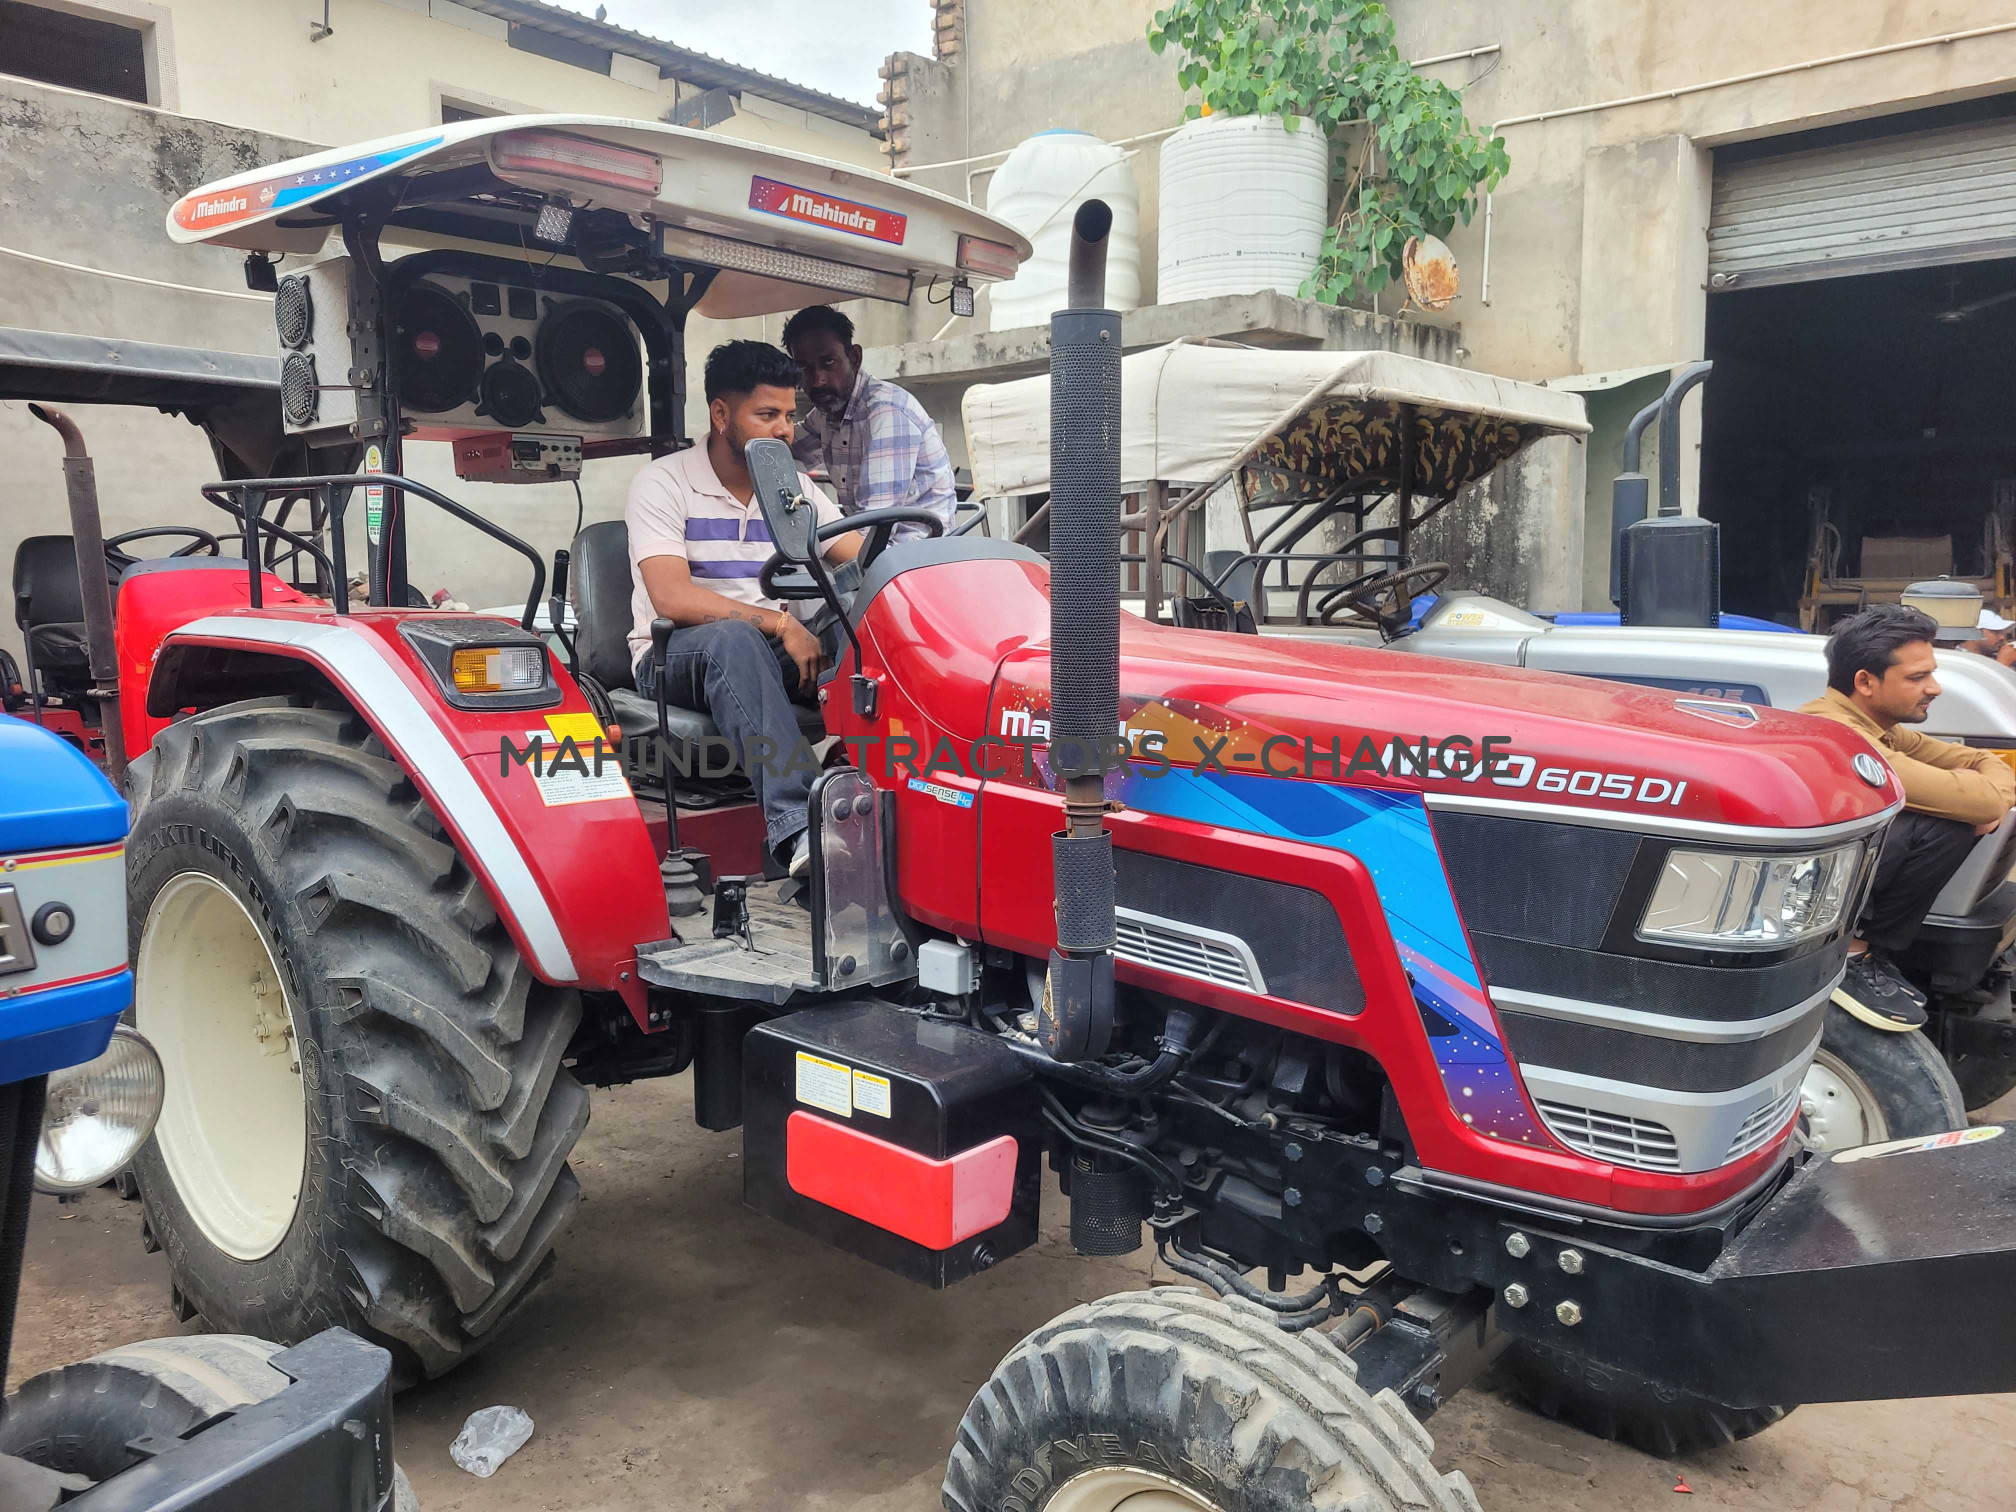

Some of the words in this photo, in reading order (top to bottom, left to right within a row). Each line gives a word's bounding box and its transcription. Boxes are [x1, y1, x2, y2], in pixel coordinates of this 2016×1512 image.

[197, 196, 247, 219] Mahindra
[792, 194, 877, 232] Mahindra
[1001, 710, 1164, 750] Mara
[199, 827, 244, 883] LIFE
